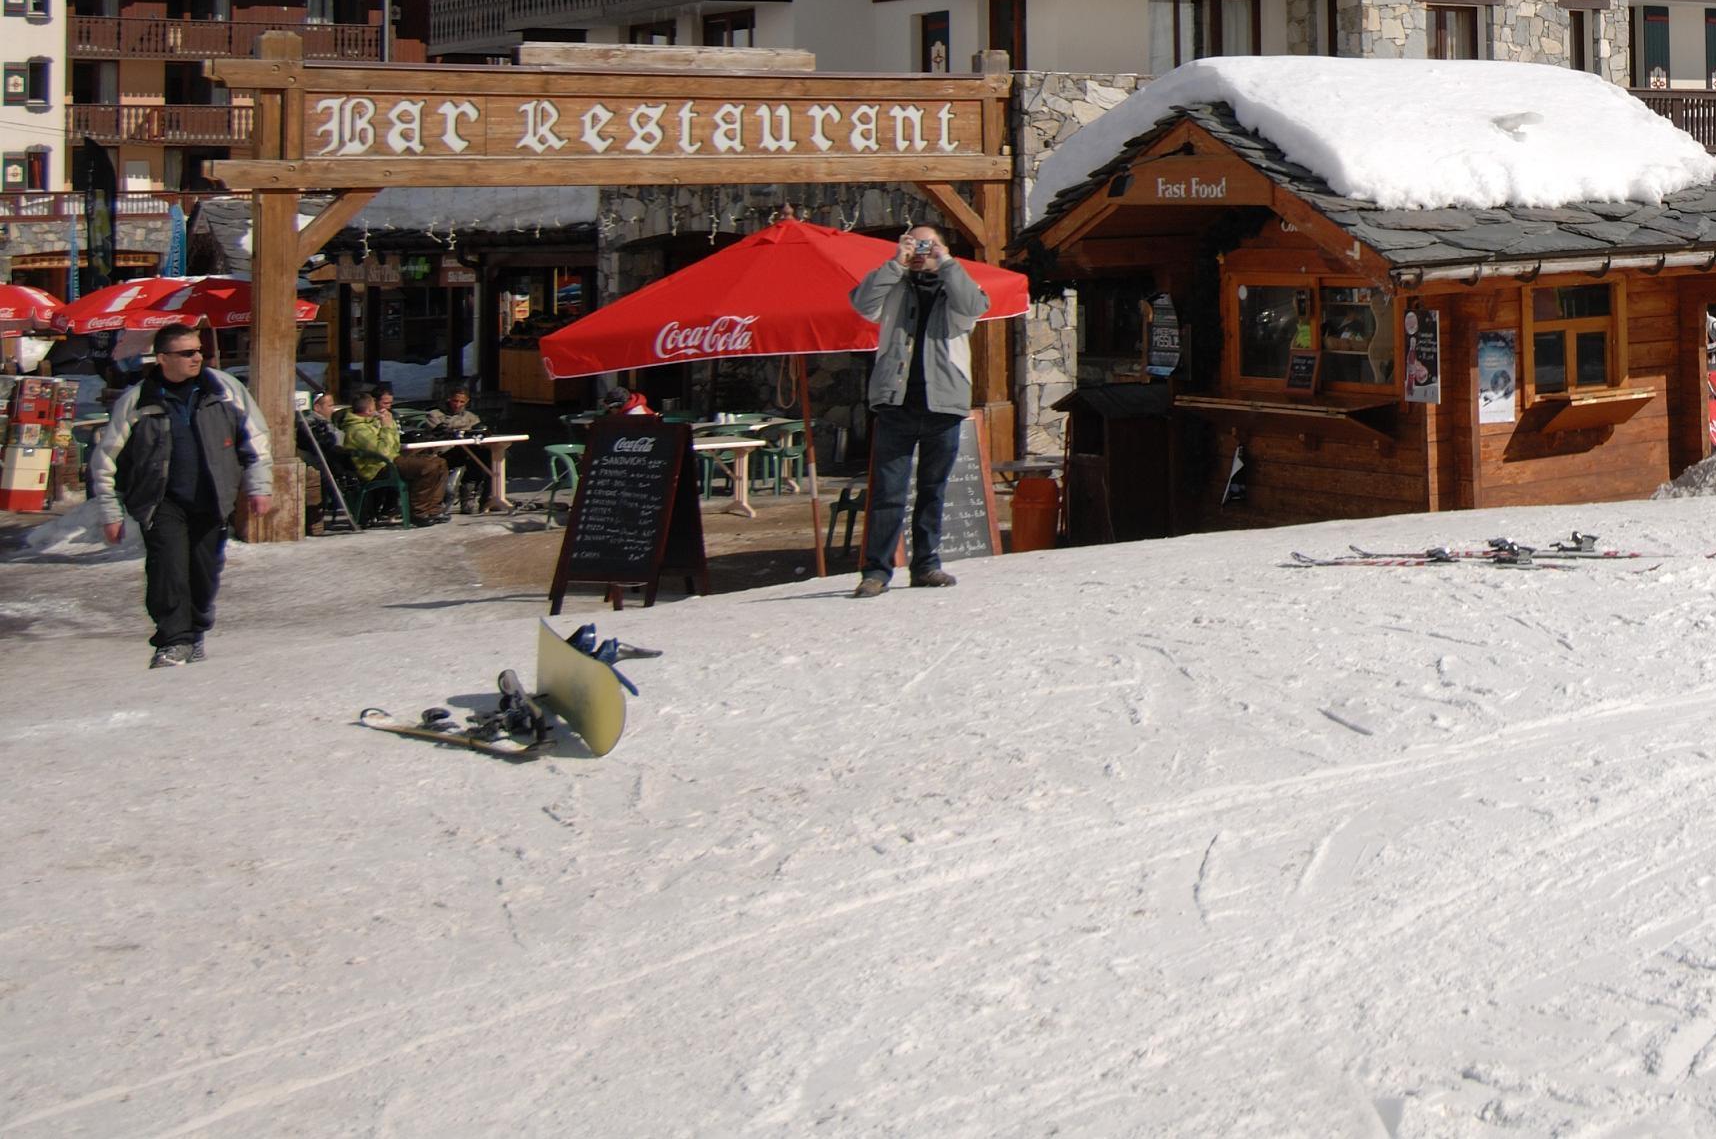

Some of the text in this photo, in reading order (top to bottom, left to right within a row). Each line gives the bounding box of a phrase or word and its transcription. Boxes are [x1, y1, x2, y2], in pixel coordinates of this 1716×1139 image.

[316, 97, 961, 156] Bar Restaurant
[1156, 177, 1226, 198] Fast Food
[88, 315, 128, 329] Coca-Cola
[655, 315, 761, 359] Coca-Cola
[613, 437, 656, 452] Coca-Cola
